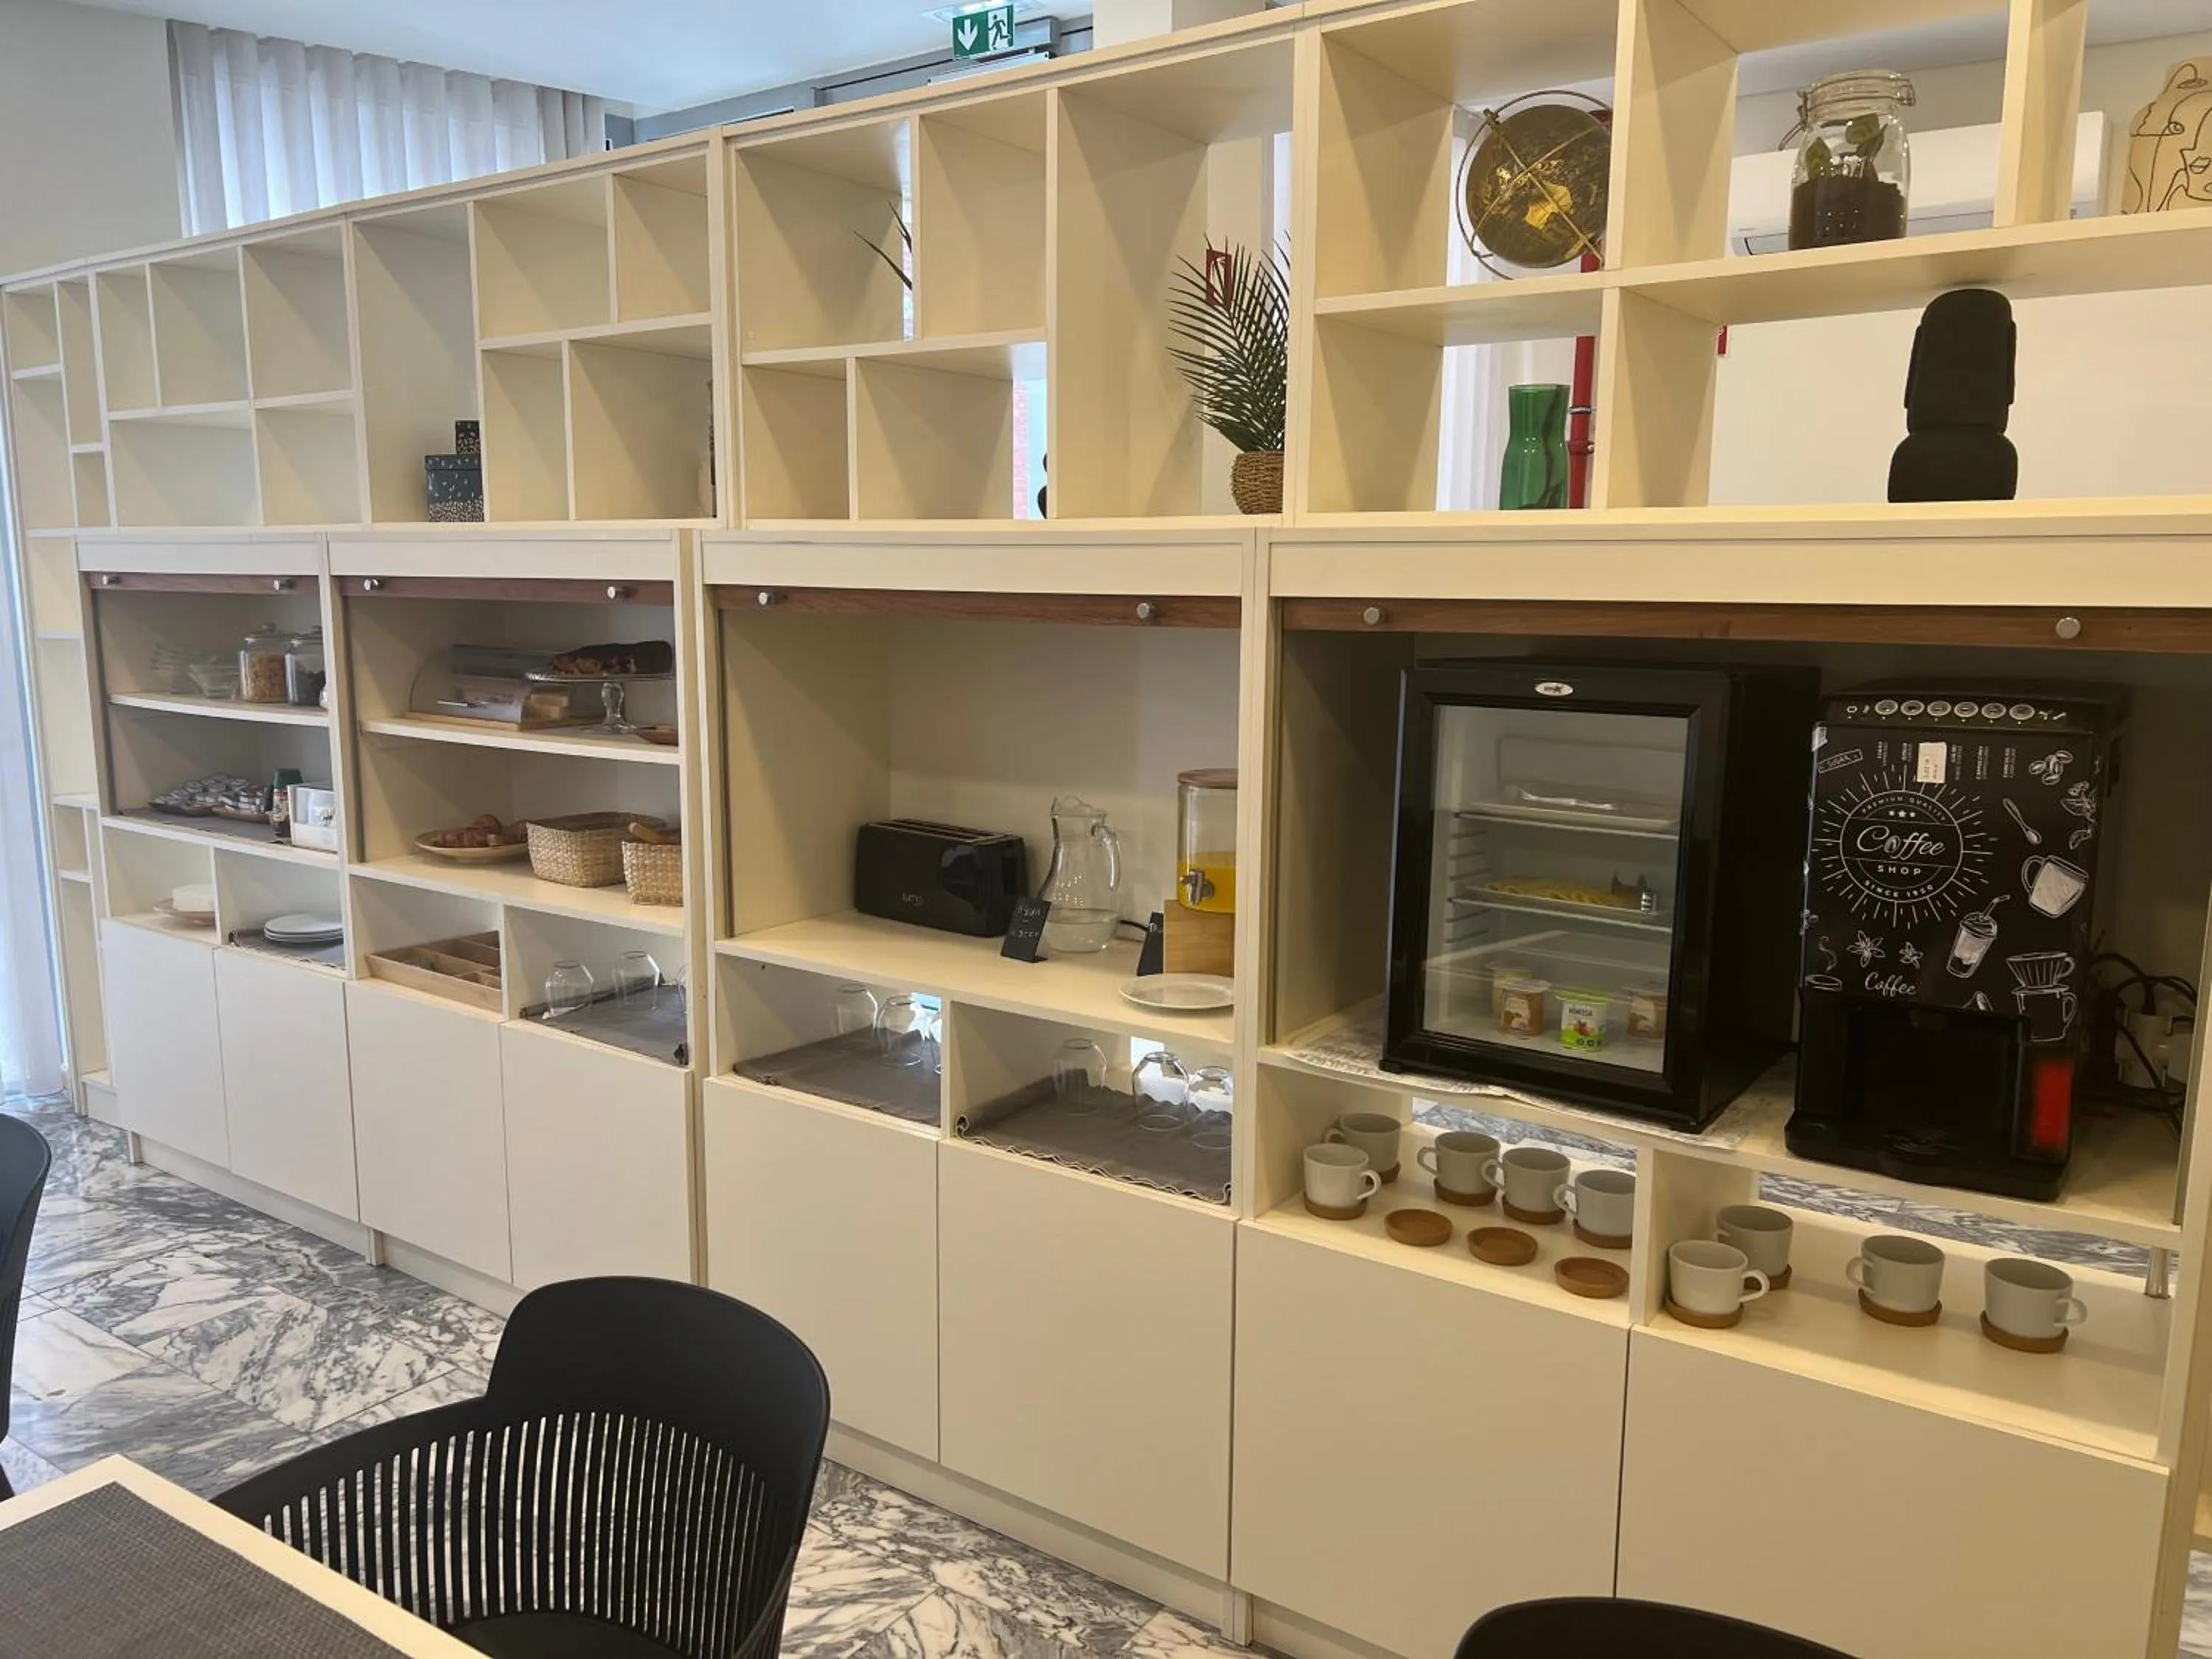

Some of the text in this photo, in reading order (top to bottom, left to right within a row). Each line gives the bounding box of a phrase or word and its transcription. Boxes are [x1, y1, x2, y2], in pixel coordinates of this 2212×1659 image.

[1862, 796, 1946, 821] PREMIUM QUALITY
[1857, 825, 1946, 860] Coffee
[1877, 865, 1921, 875] SHOP
[1865, 880, 1899, 897] SINCE
[1865, 972, 1917, 998] Coffee
